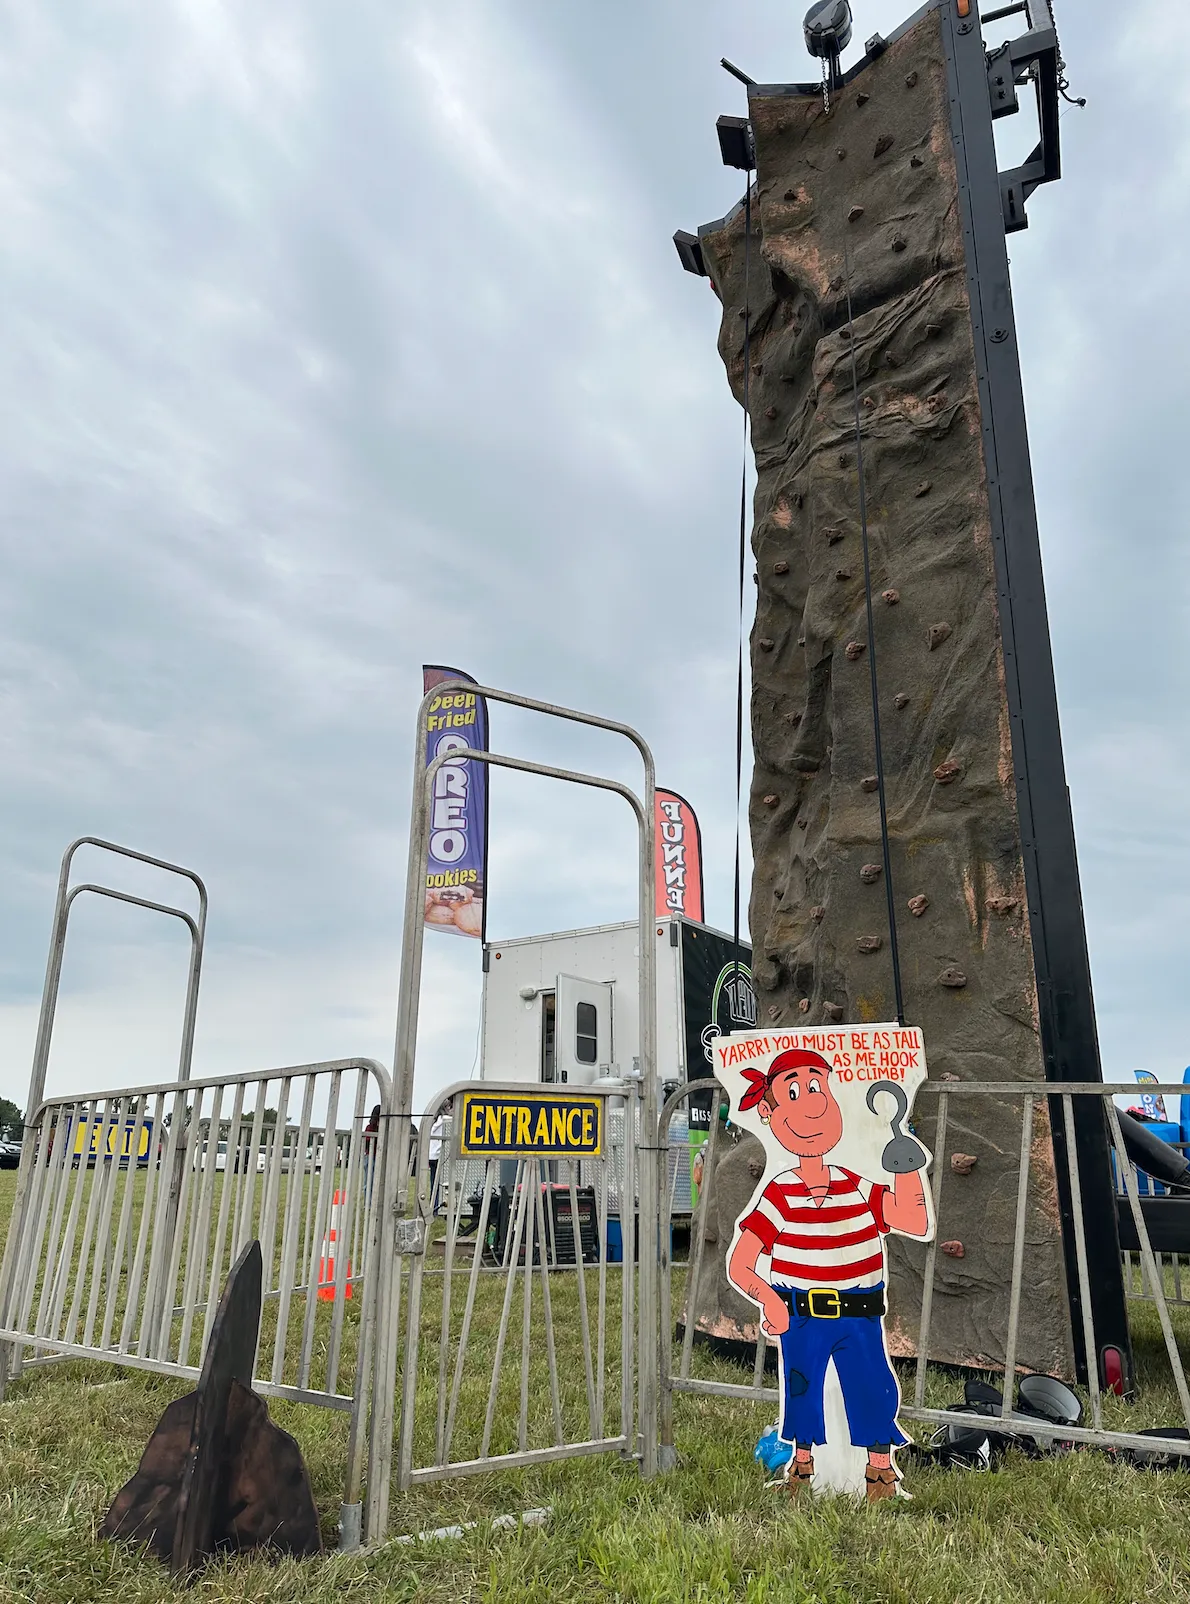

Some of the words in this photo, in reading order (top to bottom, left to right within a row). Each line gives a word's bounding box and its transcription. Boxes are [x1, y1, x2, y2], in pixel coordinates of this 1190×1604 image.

[429, 693, 476, 713] Deep
[427, 709, 476, 732] Fried
[429, 734, 469, 863] OREO
[426, 868, 477, 888] ookies
[719, 1037, 771, 1068] YARRR!
[773, 1036, 799, 1050] YOU
[803, 1034, 845, 1051] MUST
[852, 1033, 869, 1050] BE
[873, 1032, 891, 1049] AS
[892, 1031, 920, 1049] TALL
[833, 1054, 851, 1068] AS
[856, 1053, 877, 1066] ME
[880, 1052, 919, 1068] HOOK
[836, 1068, 854, 1083] TO
[857, 1068, 905, 1082] CLIMB!
[469, 1105, 594, 1146] ENTRANCE
